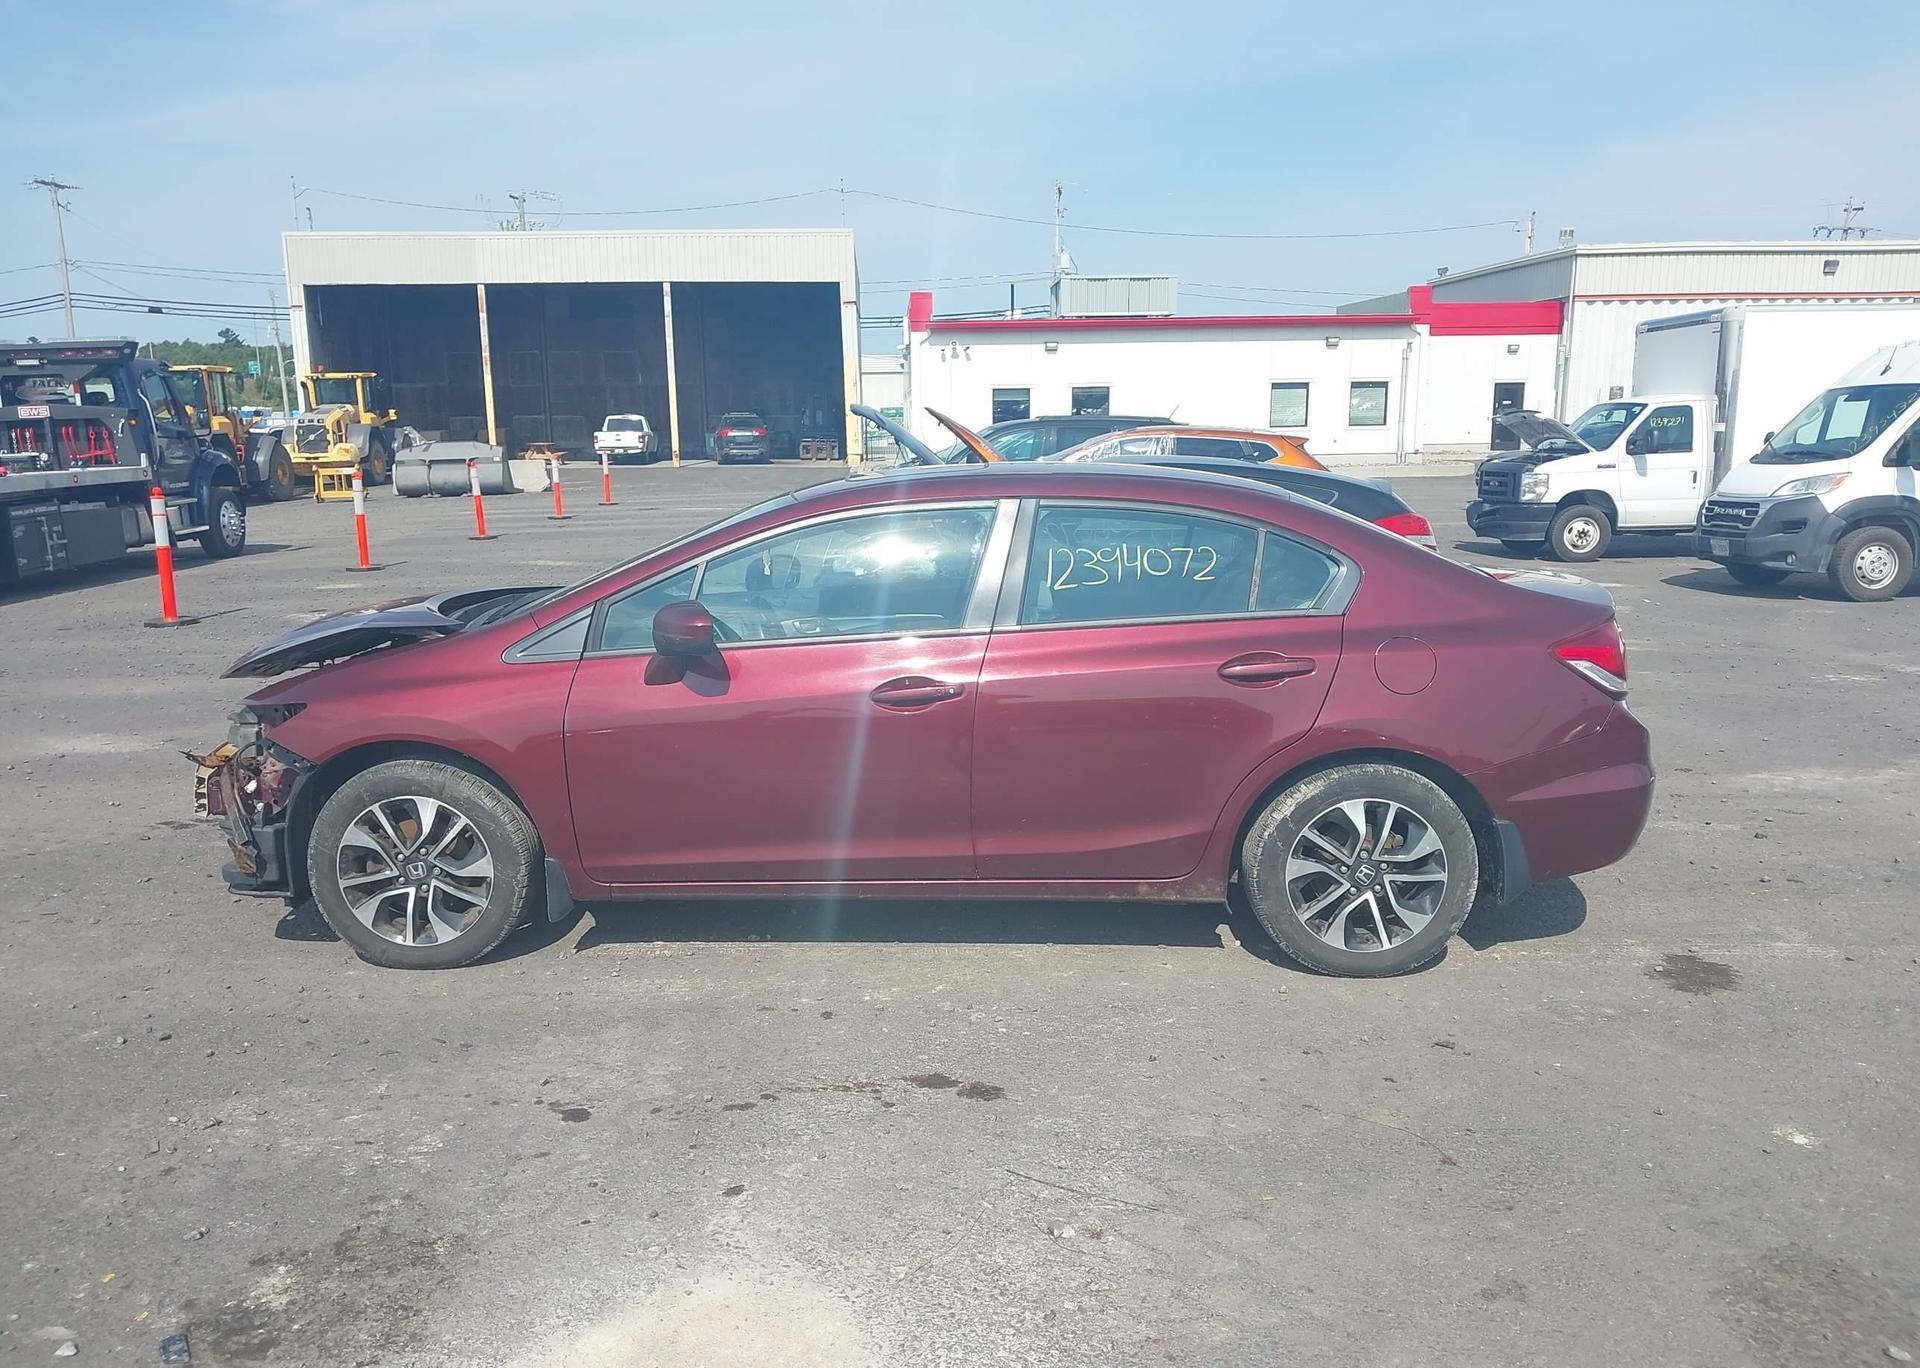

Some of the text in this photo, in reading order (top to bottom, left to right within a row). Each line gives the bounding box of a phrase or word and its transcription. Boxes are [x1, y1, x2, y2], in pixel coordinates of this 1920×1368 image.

[20, 408, 48, 417] BWS
[1716, 507, 1743, 515] RAM
[1047, 543, 1217, 591] 12394072
